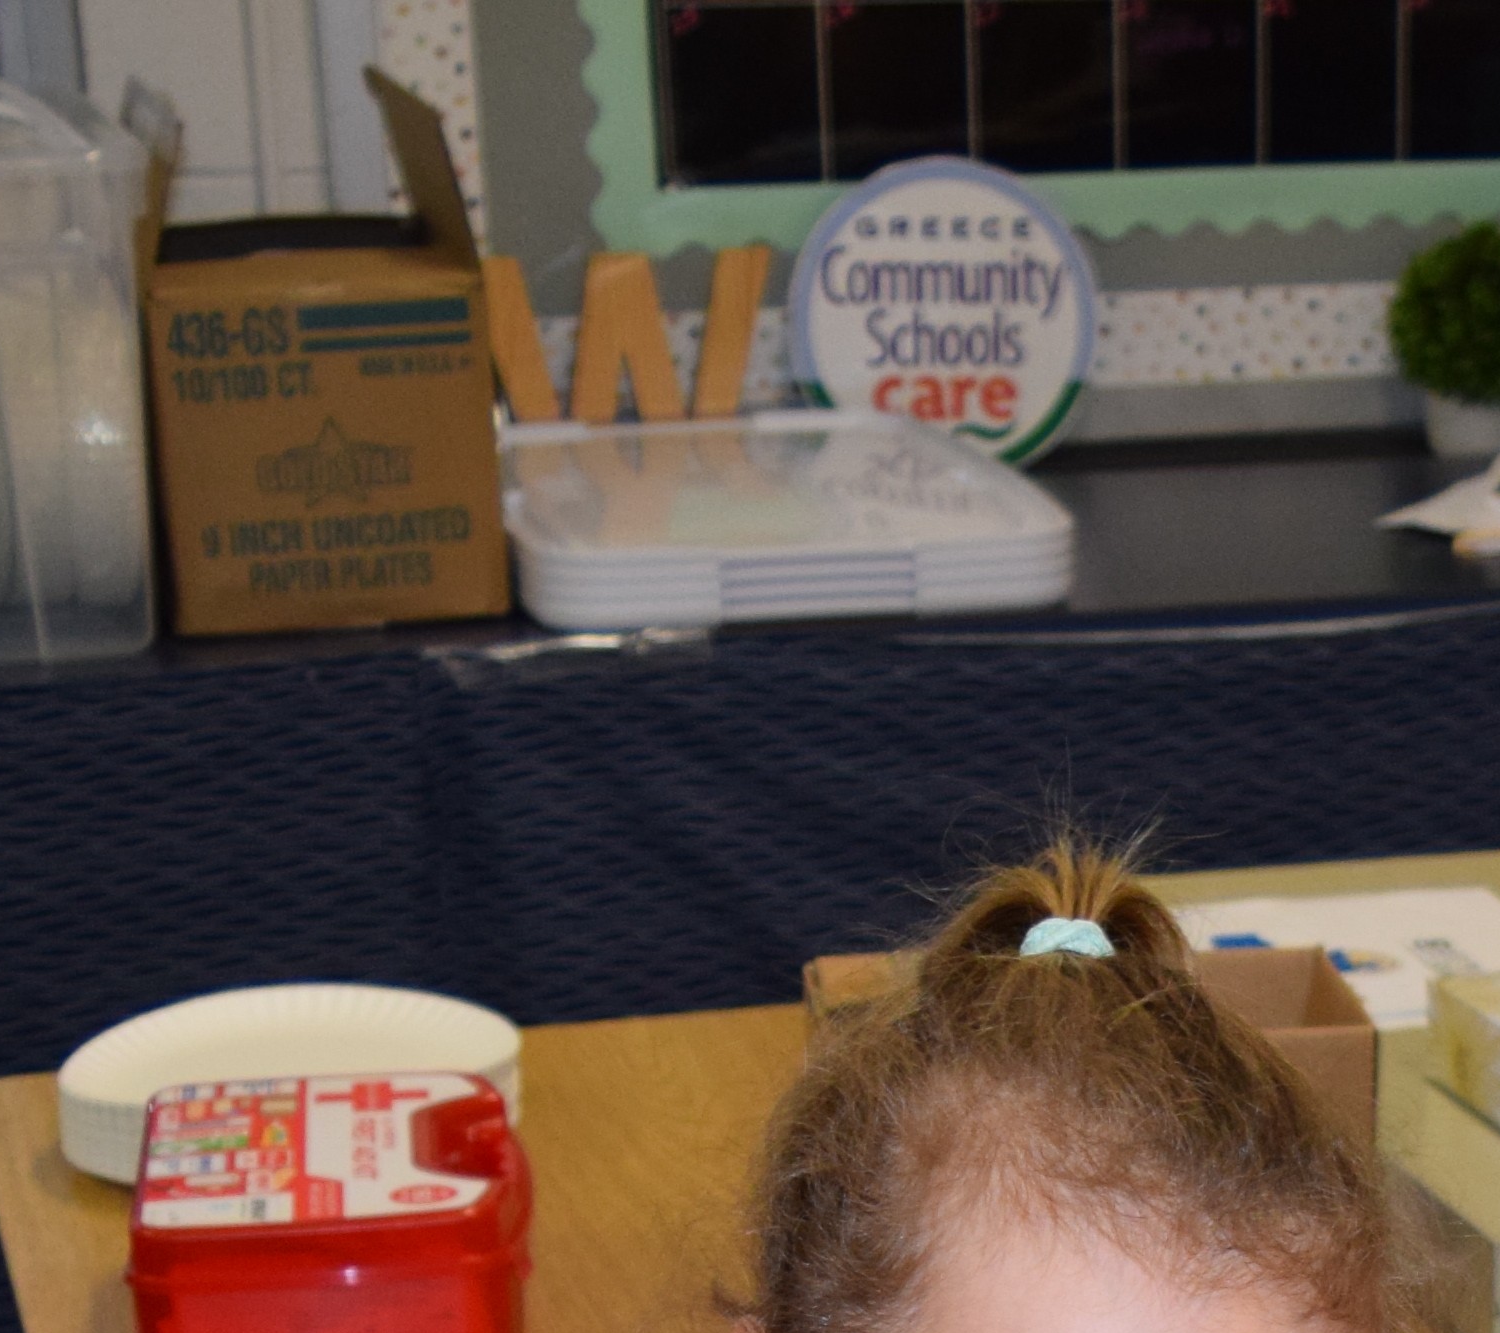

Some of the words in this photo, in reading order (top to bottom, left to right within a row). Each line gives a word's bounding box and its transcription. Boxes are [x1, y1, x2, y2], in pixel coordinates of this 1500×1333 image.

[855, 215, 1031, 239] GREECE
[821, 244, 1064, 319] Community
[866, 307, 1025, 367] Schools
[871, 375, 1018, 422] care
[230, 519, 304, 557] INCH
[311, 505, 471, 550] UNCOATED
[250, 558, 331, 593] PAPER
[339, 550, 433, 589] PLATES
